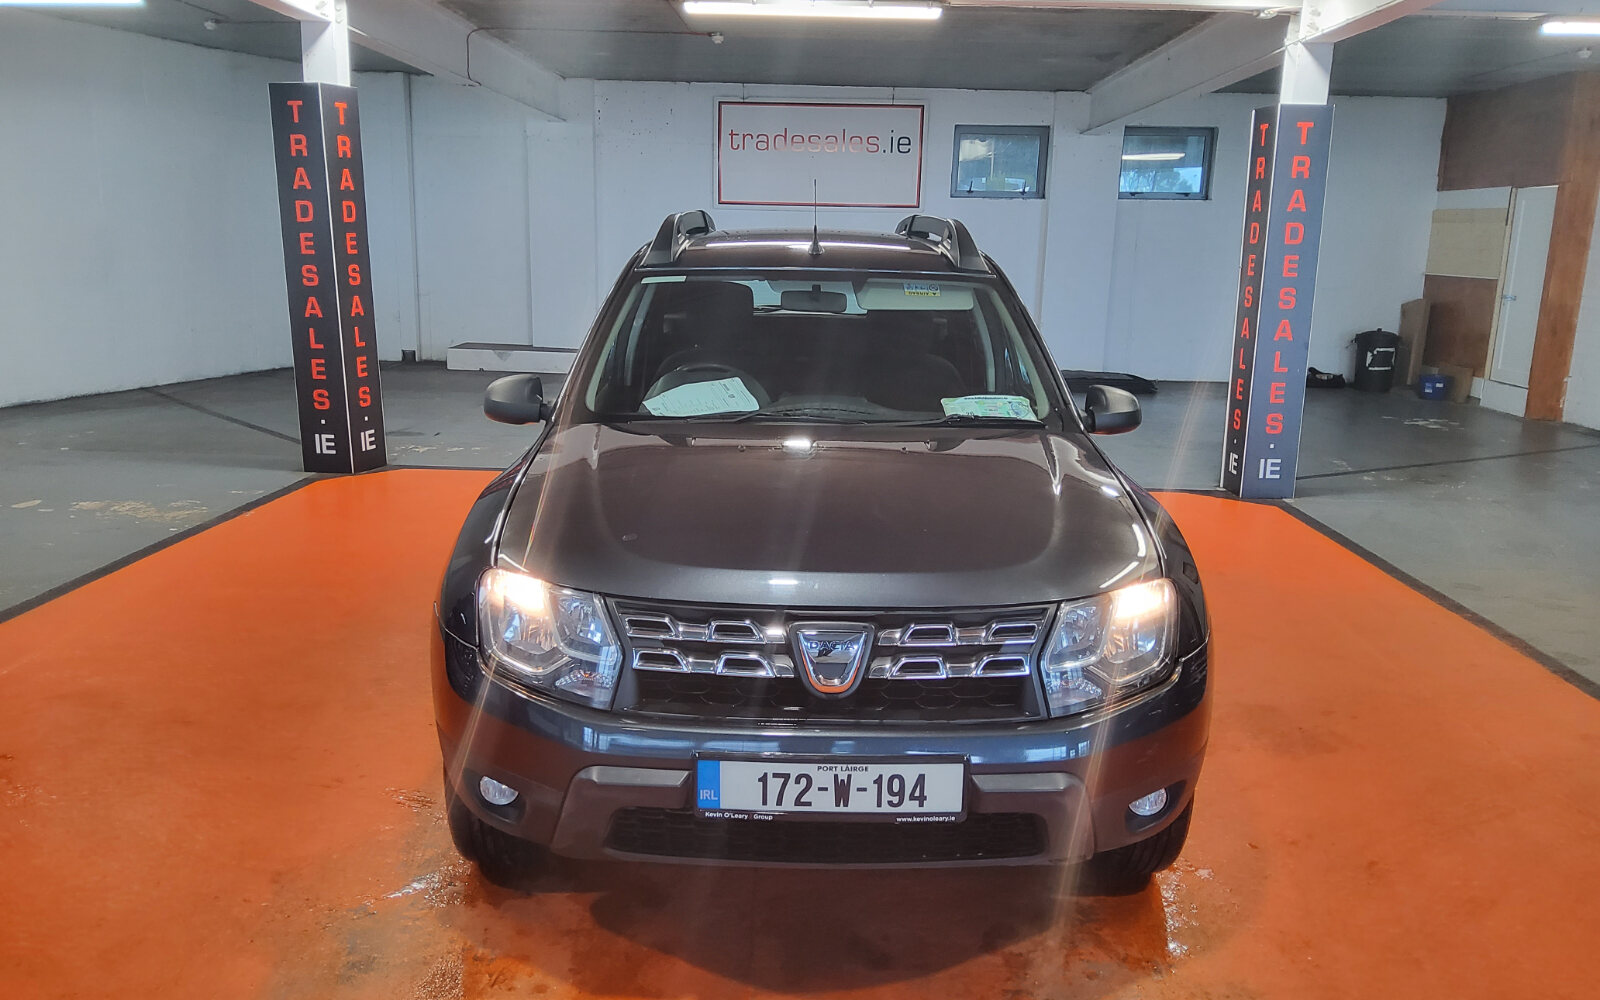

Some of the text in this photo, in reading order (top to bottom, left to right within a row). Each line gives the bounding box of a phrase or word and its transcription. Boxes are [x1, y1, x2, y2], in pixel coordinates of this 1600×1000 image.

[728, 127, 912, 154] tradesales.ie
[809, 640, 855, 650] DACIA
[700, 789, 718, 801] IRL
[757, 771, 928, 808] 172-W-194
